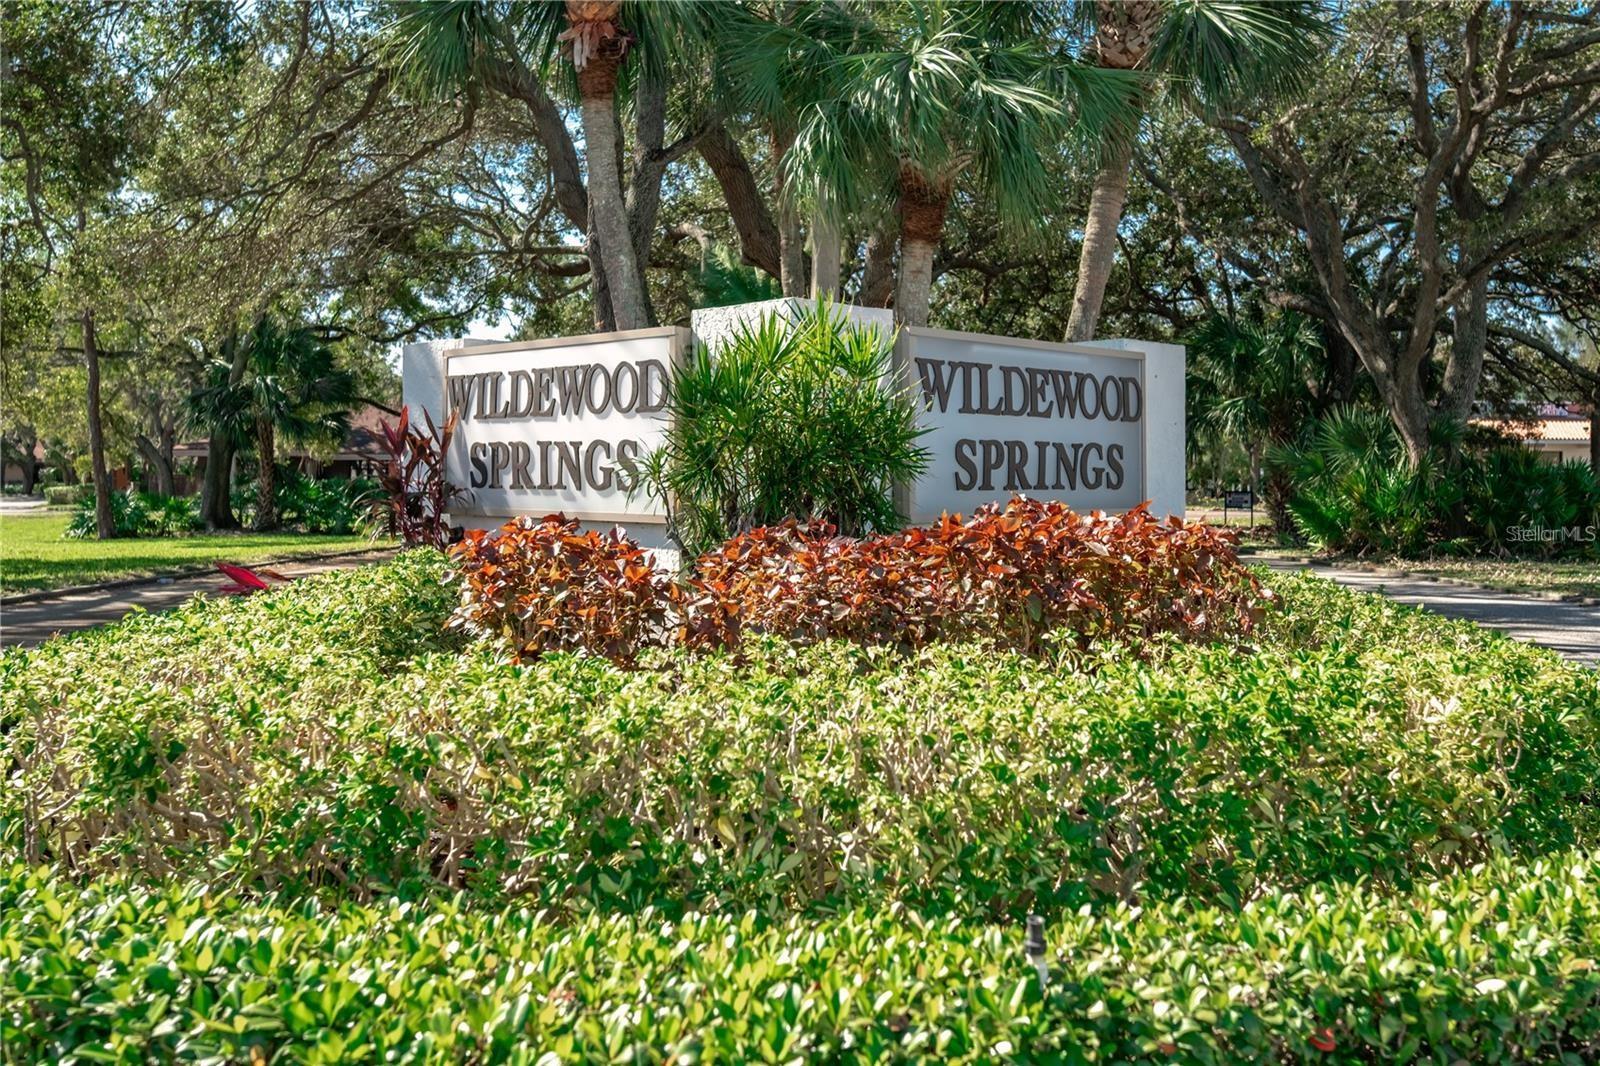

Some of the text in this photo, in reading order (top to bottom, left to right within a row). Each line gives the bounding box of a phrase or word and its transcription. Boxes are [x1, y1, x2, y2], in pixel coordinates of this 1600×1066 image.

[446, 359, 670, 420] WILDEWOOD
[914, 357, 1143, 422] WILDEWOOD
[470, 439, 640, 492] SPRINGS
[955, 438, 1125, 491] SPRINGS
